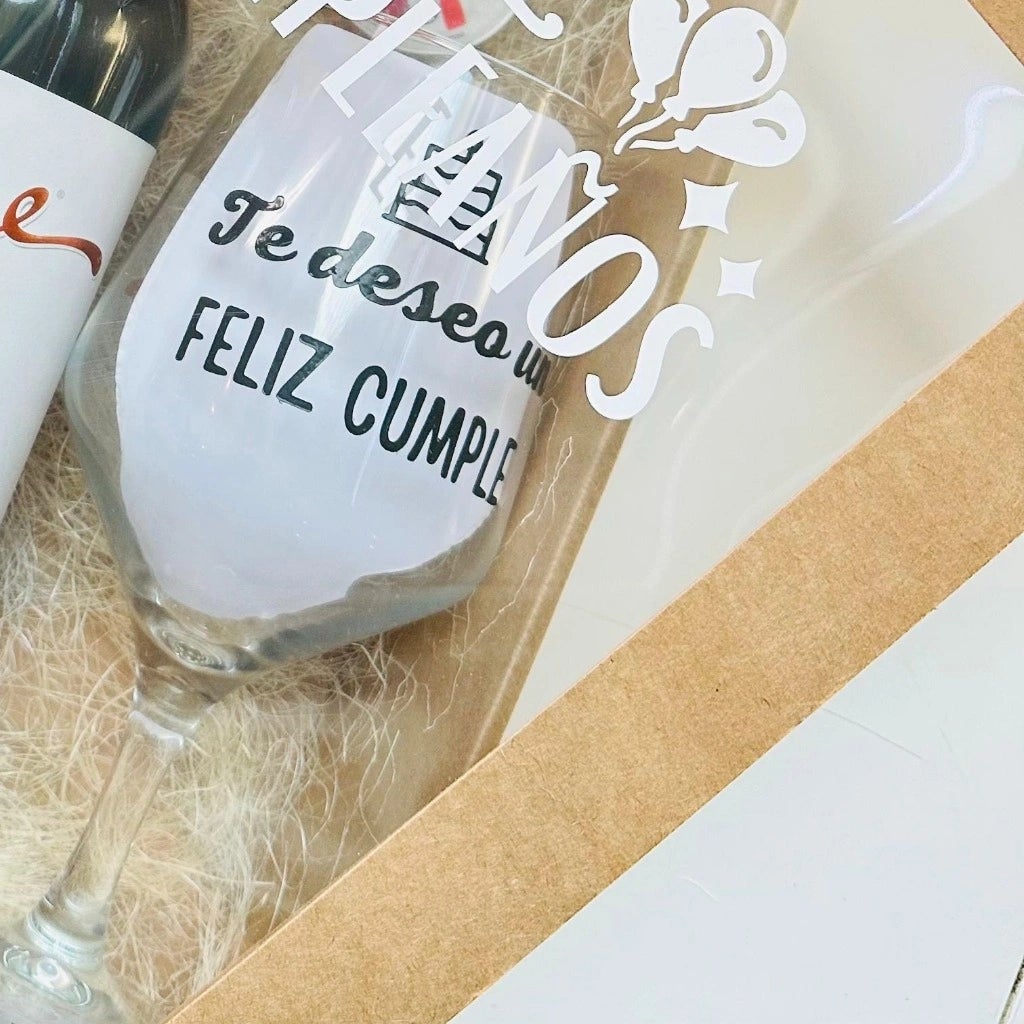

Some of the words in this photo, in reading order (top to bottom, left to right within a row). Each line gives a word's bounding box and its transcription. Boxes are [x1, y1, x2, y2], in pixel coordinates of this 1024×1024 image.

[208, 189, 298, 262] Te
[307, 231, 512, 360] deseo
[175, 296, 334, 412] FELIZ
[344, 365, 517, 506] CUMPLE
